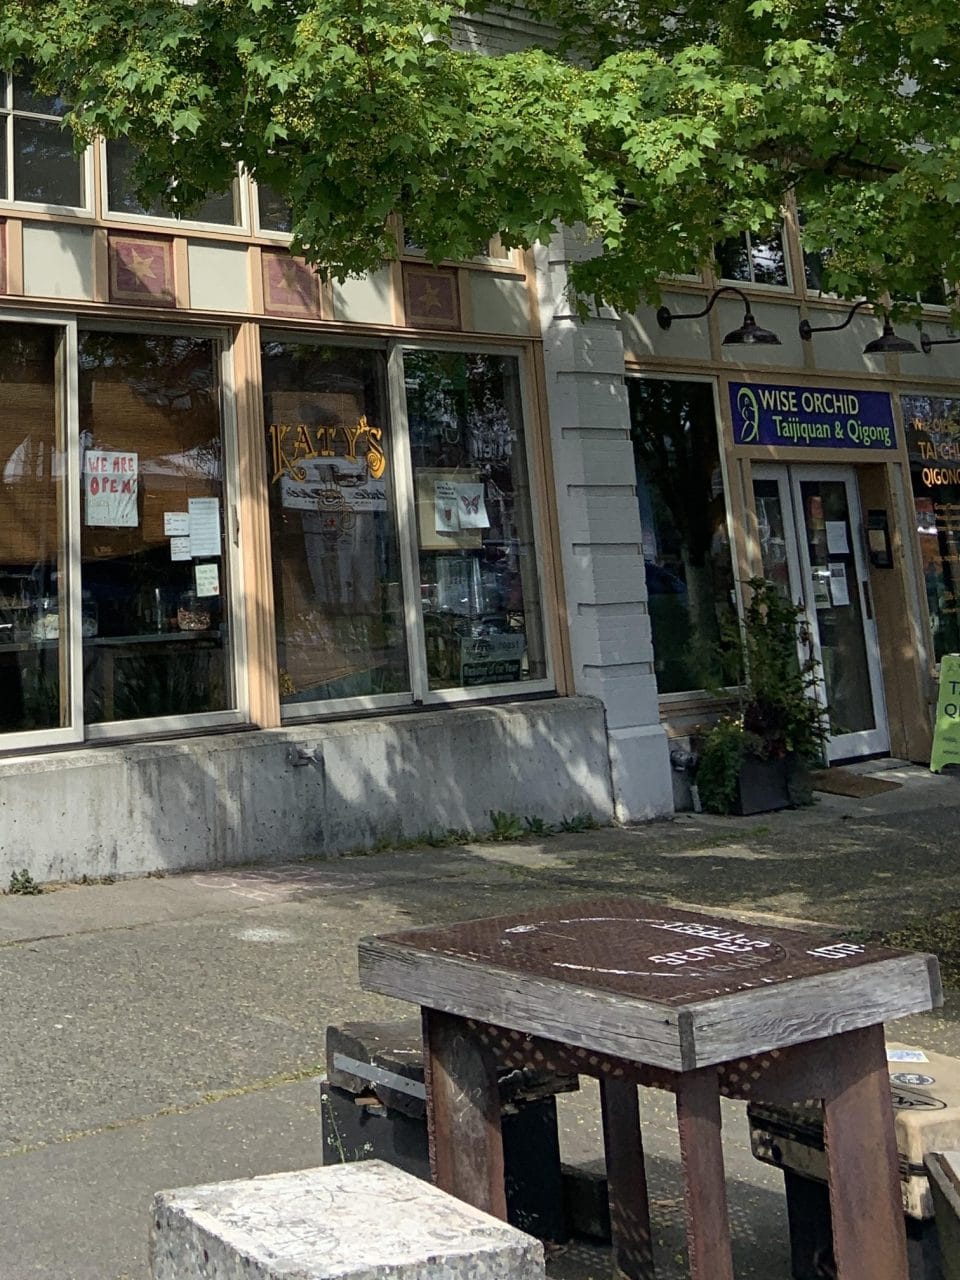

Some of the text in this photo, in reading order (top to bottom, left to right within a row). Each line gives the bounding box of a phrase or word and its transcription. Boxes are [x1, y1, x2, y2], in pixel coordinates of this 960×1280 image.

[758, 389, 859, 415] WISE ORCHID
[772, 416, 831, 444] Taijiquan
[834, 422, 844, 439] &
[847, 419, 891, 447] Qigong
[88, 456, 135, 472] WE ARE
